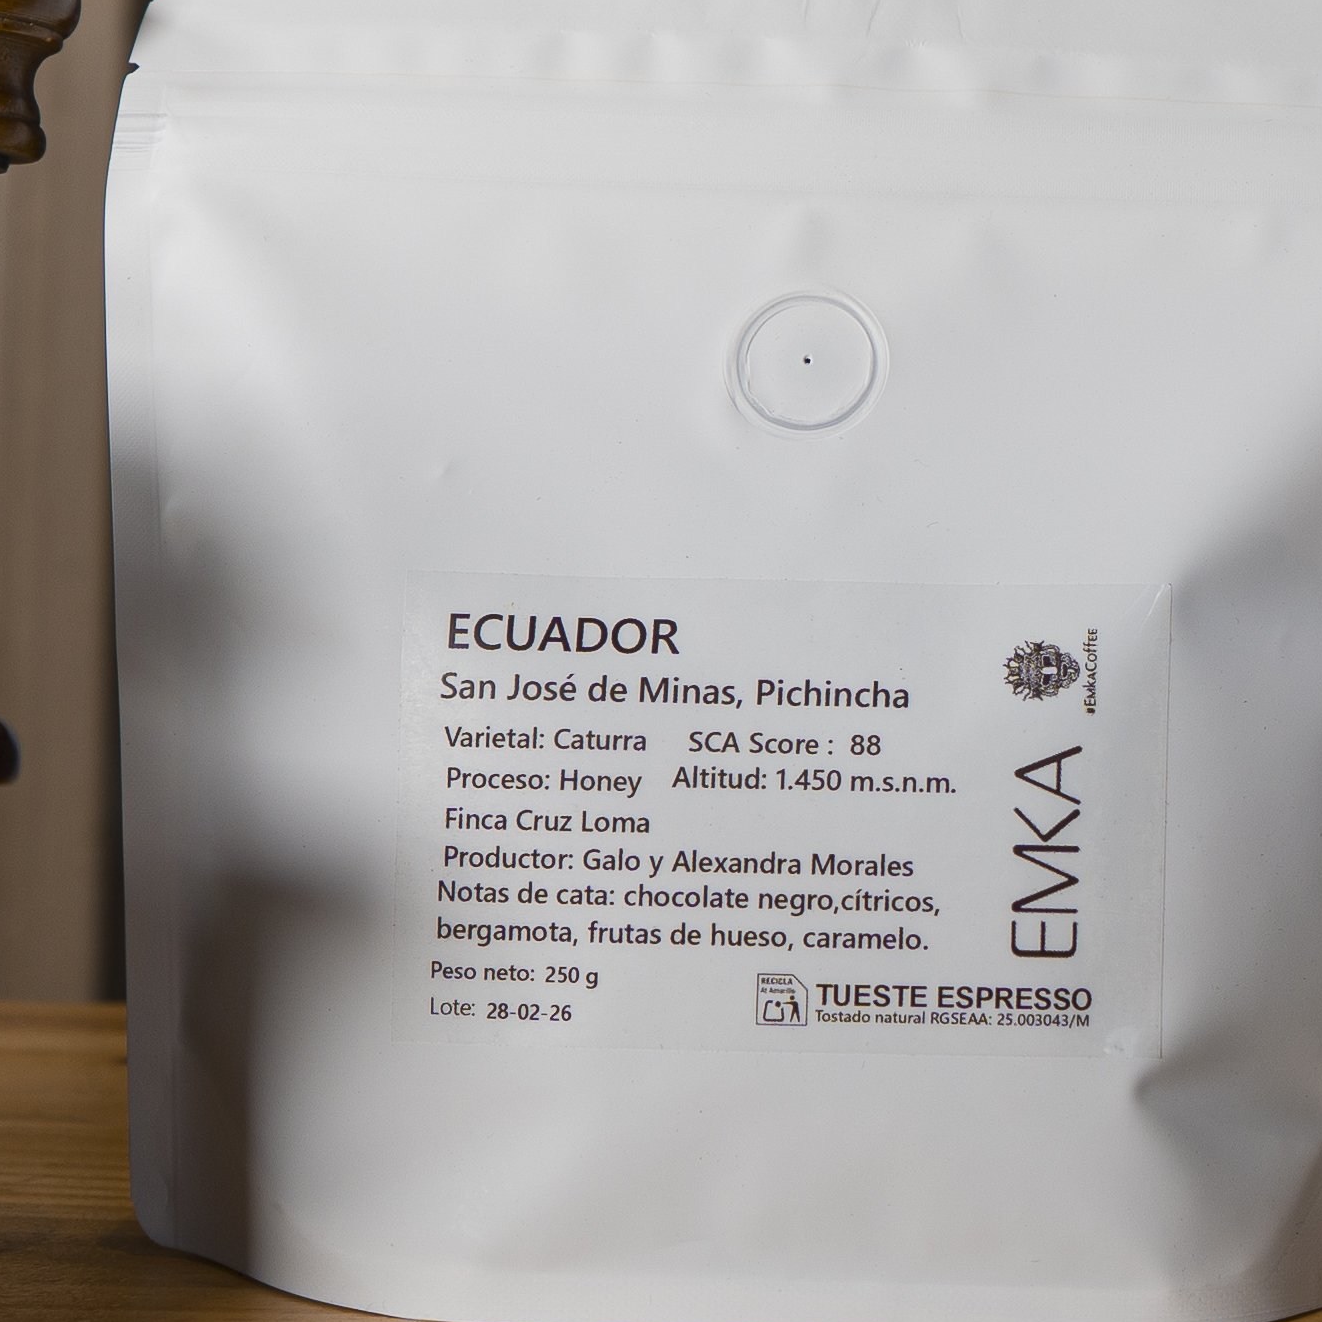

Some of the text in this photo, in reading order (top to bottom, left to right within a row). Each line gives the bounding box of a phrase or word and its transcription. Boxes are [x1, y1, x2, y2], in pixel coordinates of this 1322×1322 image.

[448, 613, 680, 654] ECUADOR
[440, 672, 909, 709] San José de Minas, Pichincha
[444, 726, 646, 751] Varietal: Caturra
[689, 731, 740, 753] SCA
[749, 732, 819, 755] Score
[850, 735, 881, 756] 88
[447, 767, 642, 798] Proceso: Honey
[672, 765, 956, 793] Altitud: 1.450 m.s.n.m.
[446, 807, 649, 833] Finca Cruz Loma
[444, 845, 913, 878] Productor: Galo y Alexandra Morales
[1011, 745, 1083, 958] EMKA
[438, 880, 509, 903] Notas
[518, 881, 548, 904] de
[556, 885, 614, 906] cata:
[624, 884, 749, 908] chocolate
[437, 916, 928, 951] bergamota, frutas de hueso, caramelo.
[431, 961, 598, 989] Peso neto: 250 g
[431, 997, 572, 1021] Lote: 28-02-26
[816, 984, 1092, 1011] TUESTE ESPRESSO
[815, 1009, 1089, 1028] Tostado natural RGSEAA: 25.003043/M
